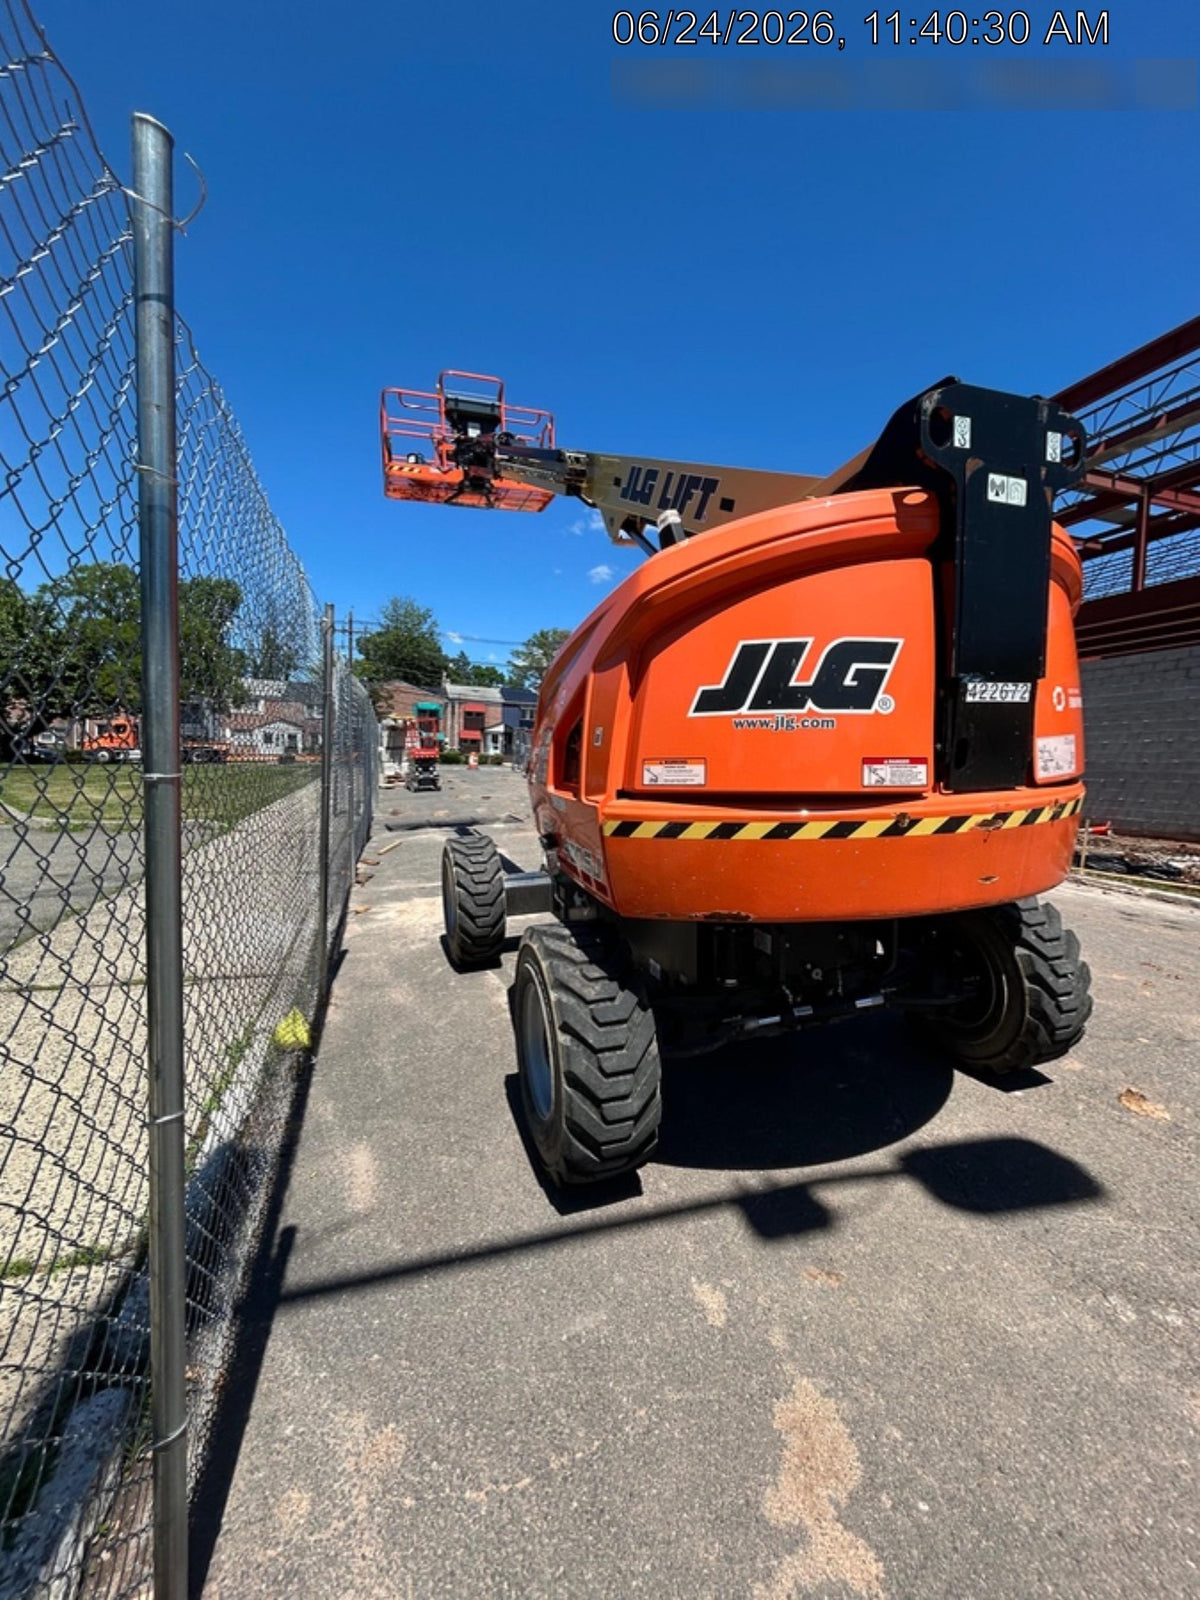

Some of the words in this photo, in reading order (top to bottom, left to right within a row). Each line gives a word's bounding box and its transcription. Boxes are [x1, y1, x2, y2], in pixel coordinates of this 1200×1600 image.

[620, 465, 660, 506] JLG
[657, 470, 721, 520] LIFT
[687, 637, 904, 717] JLG
[733, 715, 836, 732] www.jlg.com
